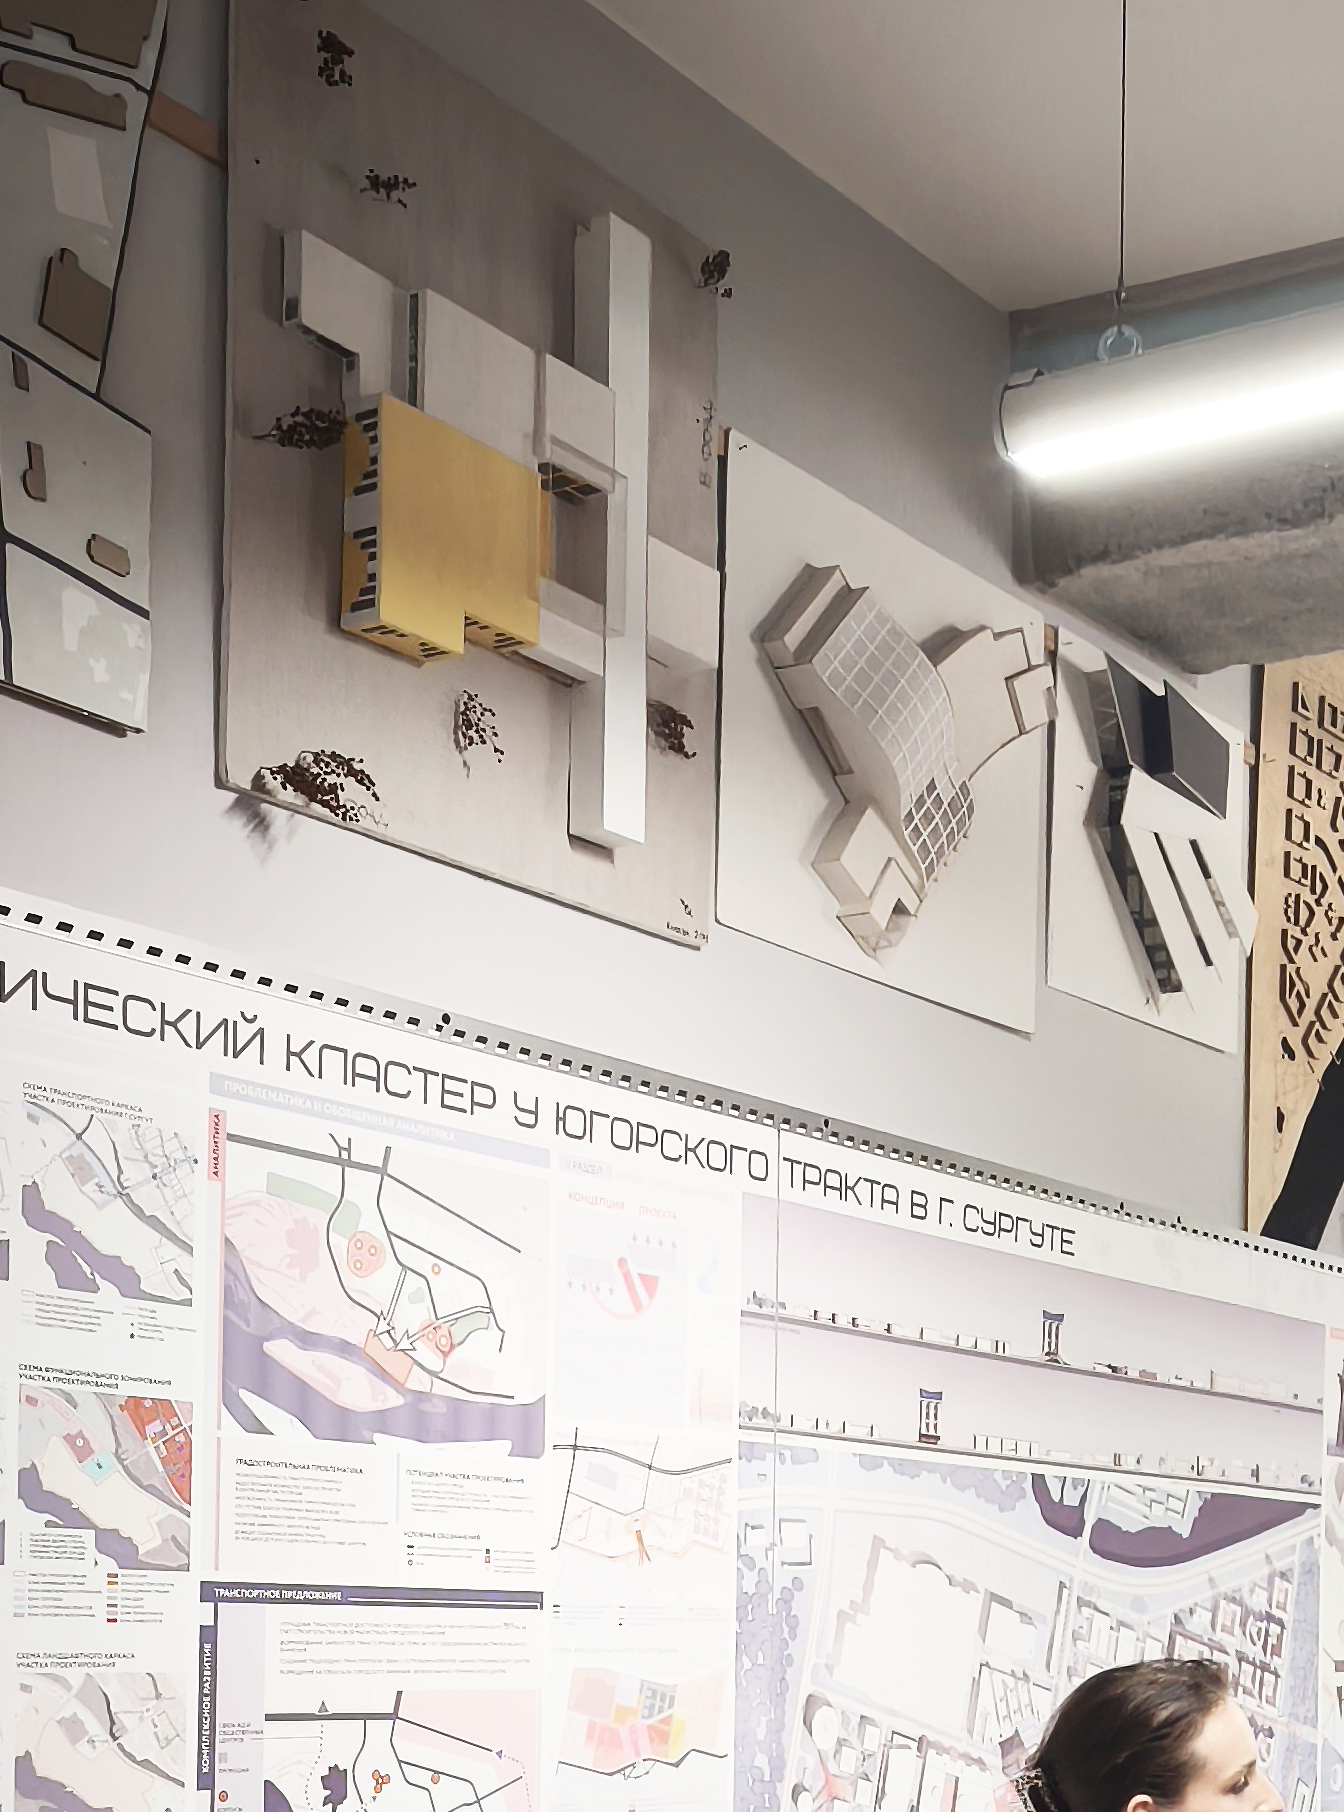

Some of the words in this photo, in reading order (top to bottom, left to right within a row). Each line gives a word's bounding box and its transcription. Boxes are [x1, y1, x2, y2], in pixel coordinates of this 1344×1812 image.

[0, 960, 264, 1066] ИЧЕСКИЙ
[285, 1034, 497, 1115] КЛАСТЕР
[513, 1090, 539, 1129] У
[555, 1101, 769, 1182] ЮГОРСКОГО
[783, 1156, 899, 1214] ТРАКТА
[910, 1189, 929, 1221] В
[938, 1196, 954, 1228] Г.
[963, 1203, 1075, 1257] СУРГУТЕ
[224, 1079, 312, 1111] ПРОБЛЕМАТИКА
[314, 1100, 321, 1112] И
[324, 1103, 395, 1129] ОБОБЩЕННАЯ
[395, 1119, 456, 1143] АНАЛИТИКА
[212, 1113, 221, 1178] АНАЛИТИКА
[568, 1191, 625, 1211] КОНЦЕПЦИЯ
[638, 1205, 678, 1220] ПРОЕКТА
[214, 1587, 280, 1600] ТРАНСПОРТНОЕ
[282, 1588, 342, 1601] ПРЕДЛОЖЕНИЕ
[202, 1642, 212, 1694] РАЗВИТИЕ
[201, 1695, 212, 1773] КОМПЛЕКСНОЕ
